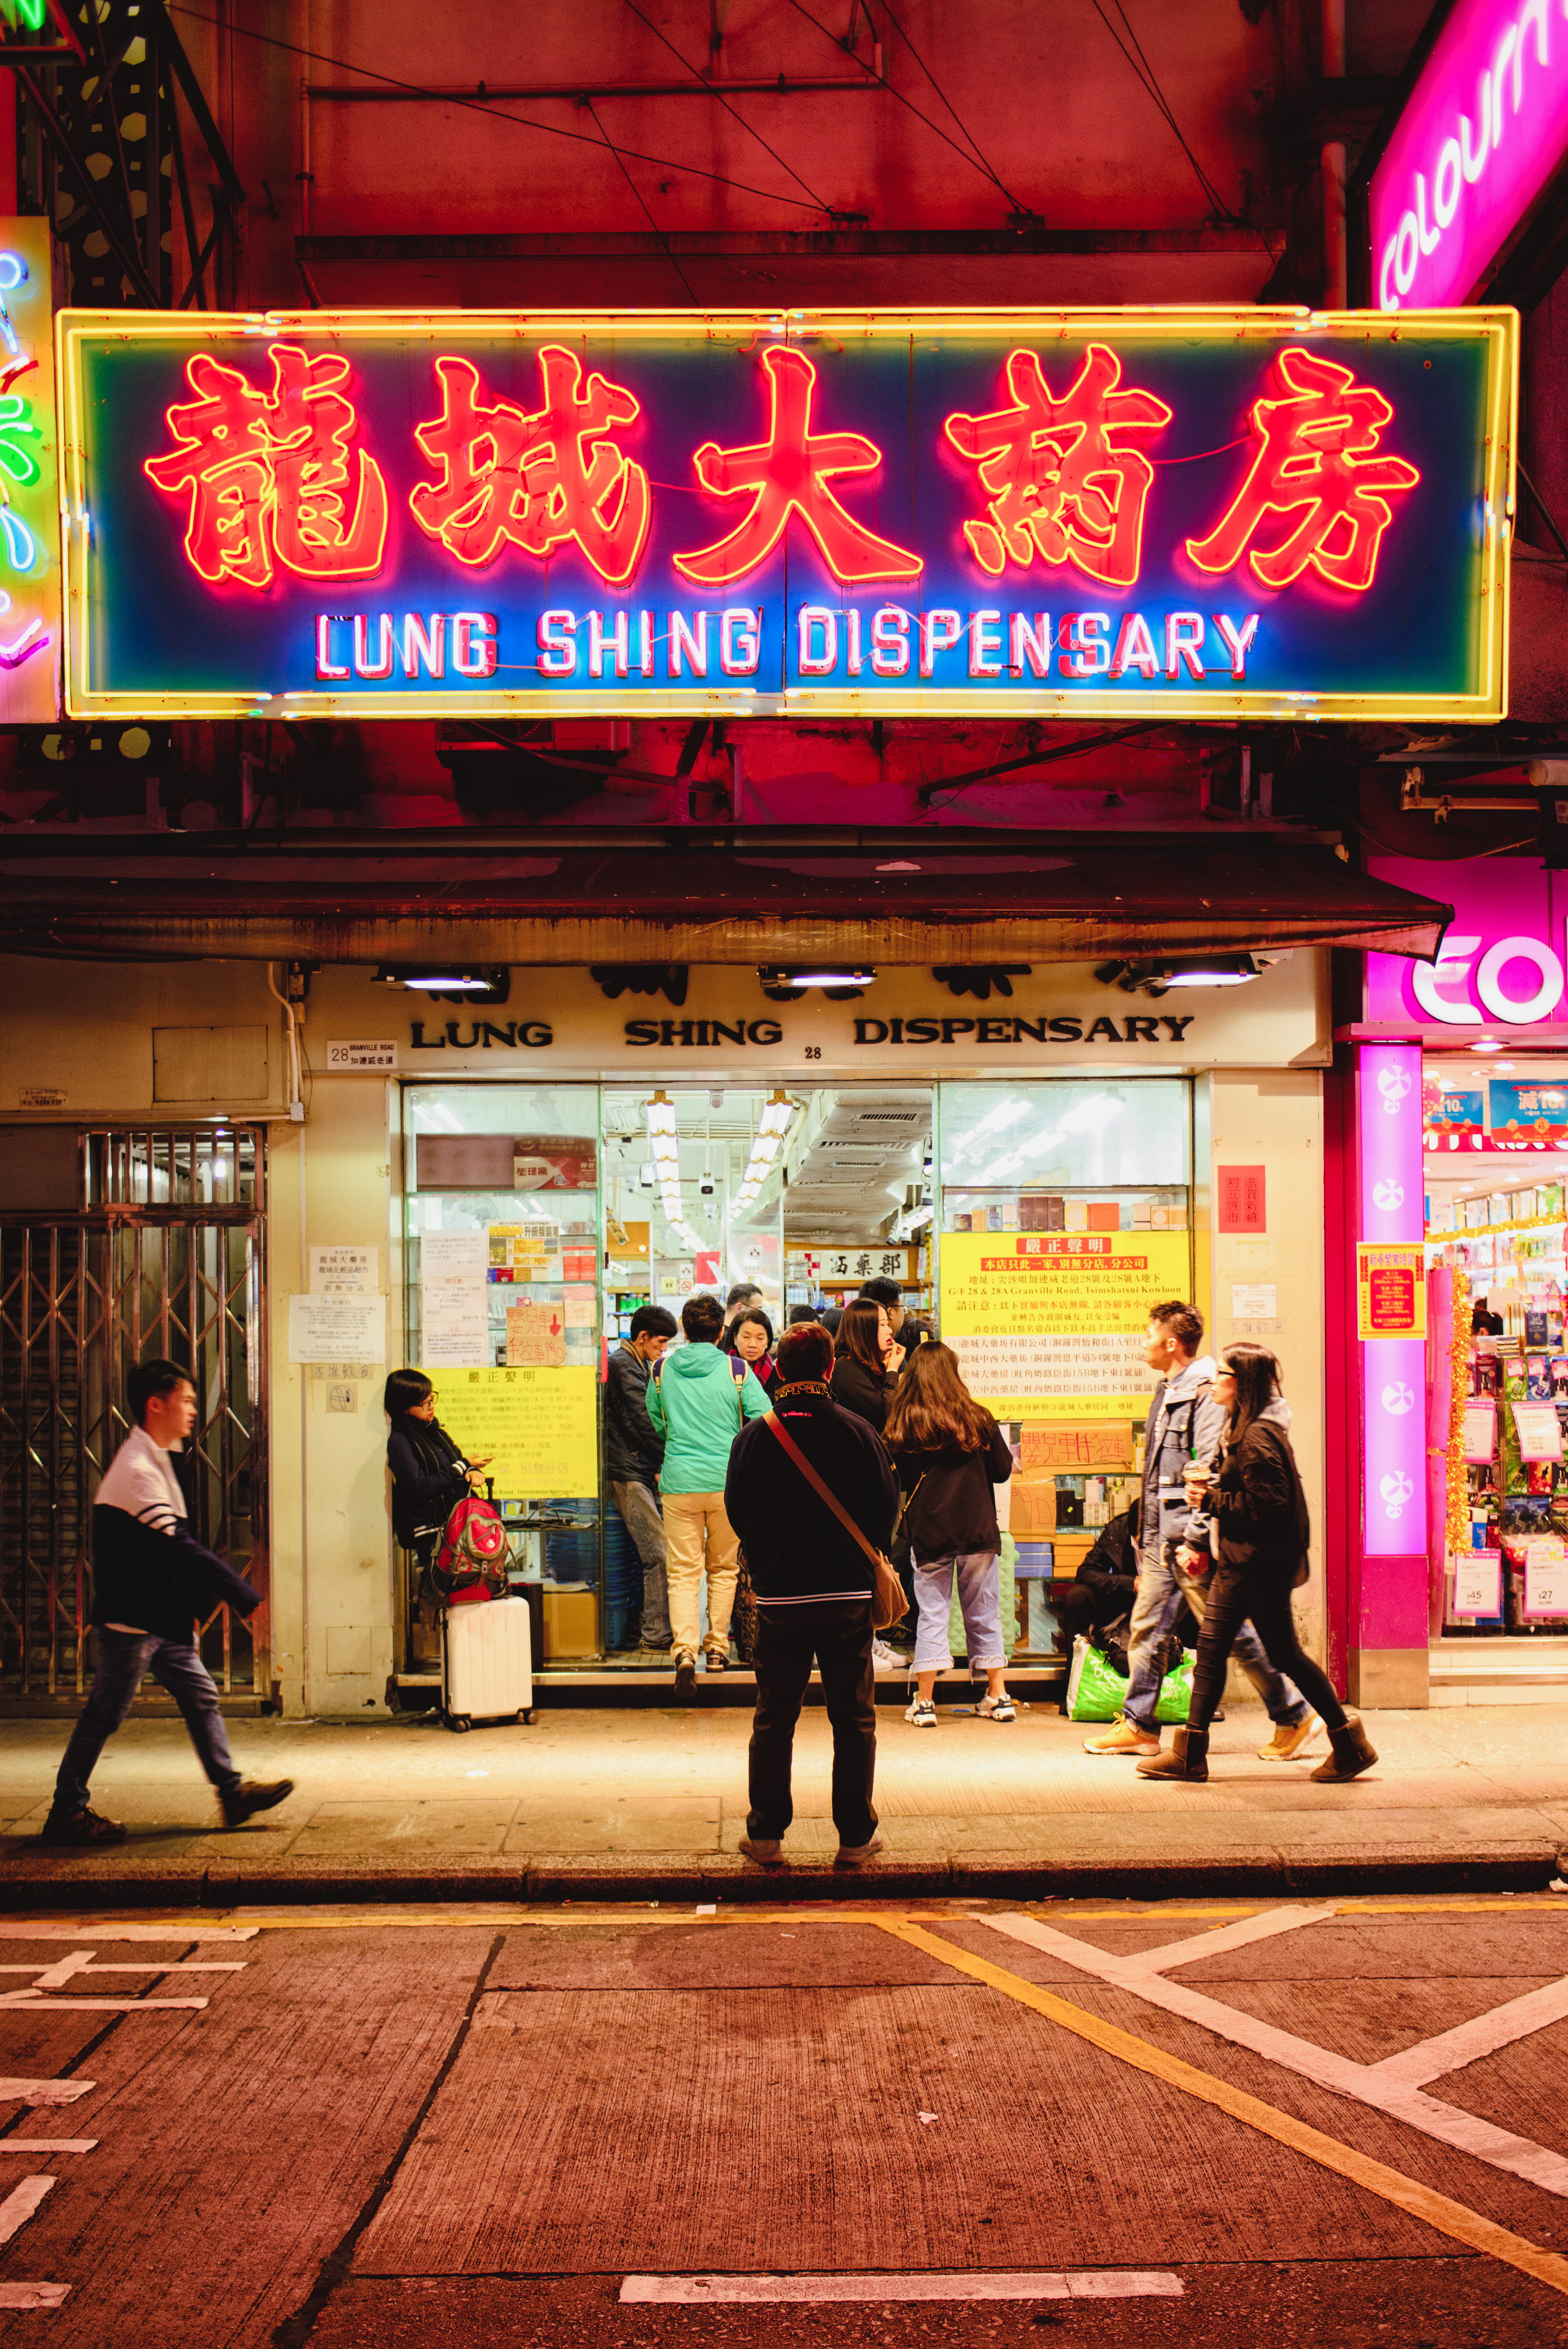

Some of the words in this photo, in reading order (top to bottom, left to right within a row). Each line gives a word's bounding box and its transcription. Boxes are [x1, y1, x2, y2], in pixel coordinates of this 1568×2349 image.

[315, 612, 497, 680] LUNG
[536, 608, 759, 678] SHING
[797, 606, 1261, 680] DISPENSARY
[410, 1021, 553, 1048] LUNG
[624, 1019, 783, 1047] SHING
[854, 1016, 1194, 1044] DISPENSARY
[332, 1048, 349, 1061] 28
[805, 1047, 821, 1059] 28
[351, 1056, 393, 1065] 加連威老道
[517, 1167, 547, 1176] 必理痛
[1246, 1177, 1257, 1223] 恭賀新禧
[1026, 1238, 1103, 1254] 嚴正聲明
[324, 1284, 365, 1292] 別無分店
[1142, 1285, 1181, 1293] Kowloon
[315, 1364, 370, 1378] 不准飲食
[468, 1370, 536, 1383] 嚴正聲明
